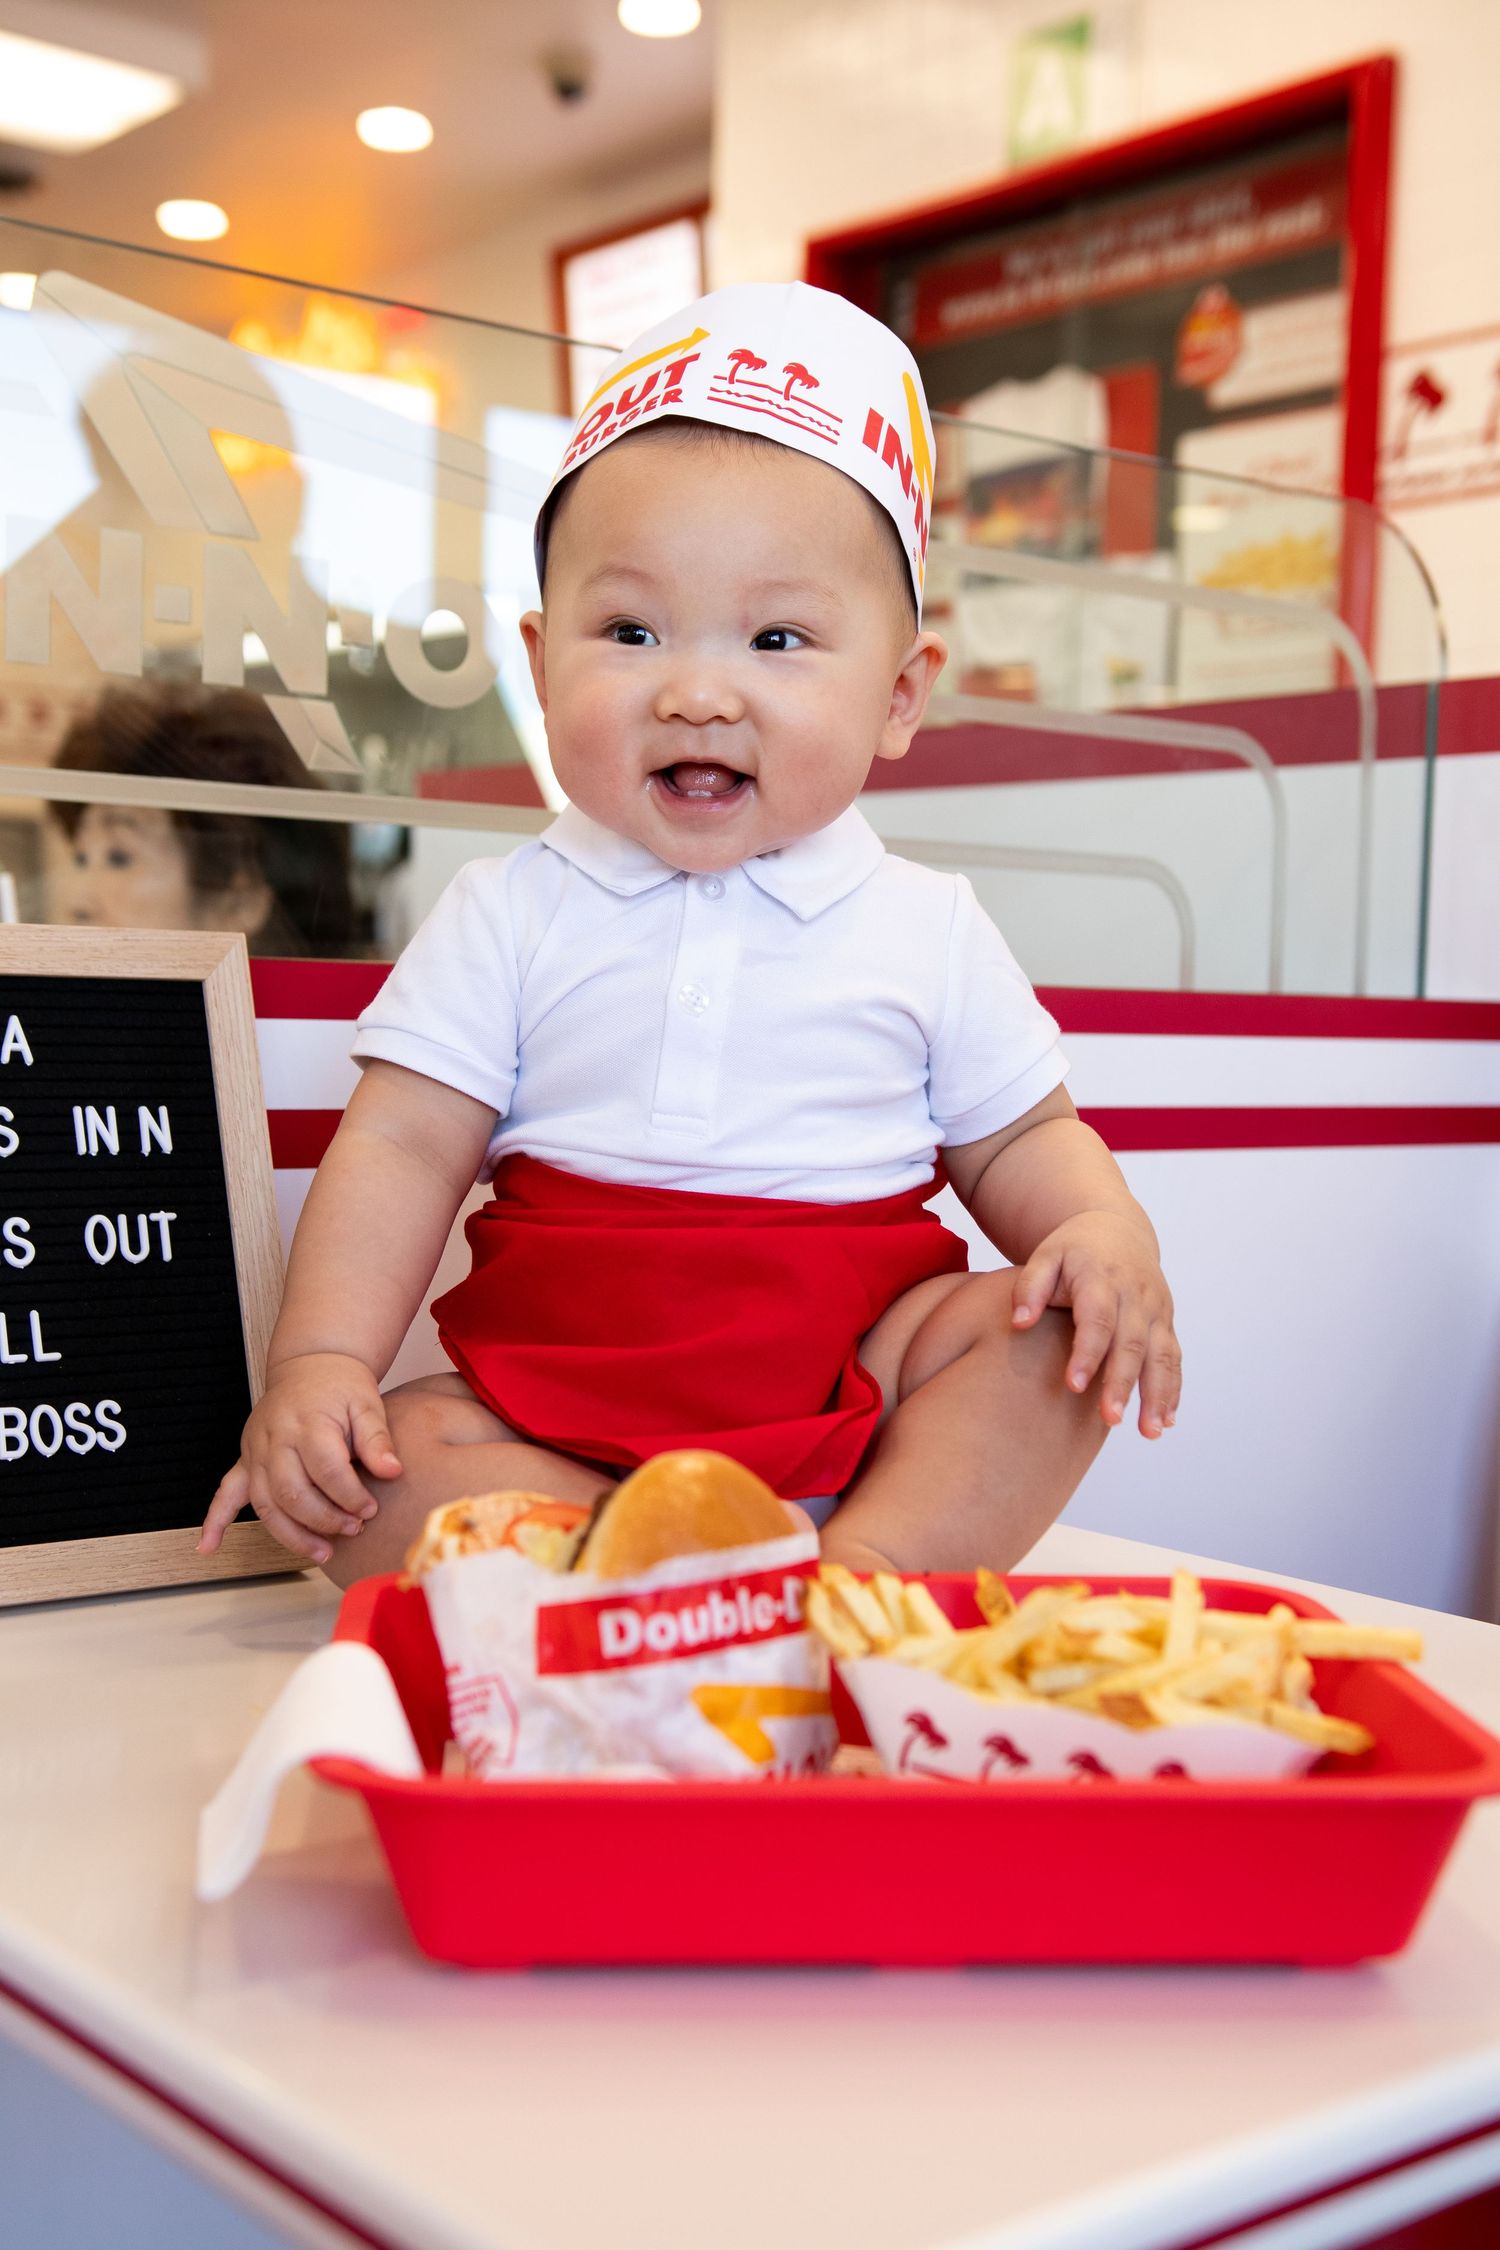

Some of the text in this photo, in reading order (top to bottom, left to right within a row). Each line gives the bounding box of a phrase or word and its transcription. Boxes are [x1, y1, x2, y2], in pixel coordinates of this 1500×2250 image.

[562, 388, 683, 470] BURGER
[72, 1105, 120, 1156] IN
[138, 1105, 173, 1157] N
[84, 1211, 177, 1265] OUT
[0, 1400, 127, 1461] BOSS
